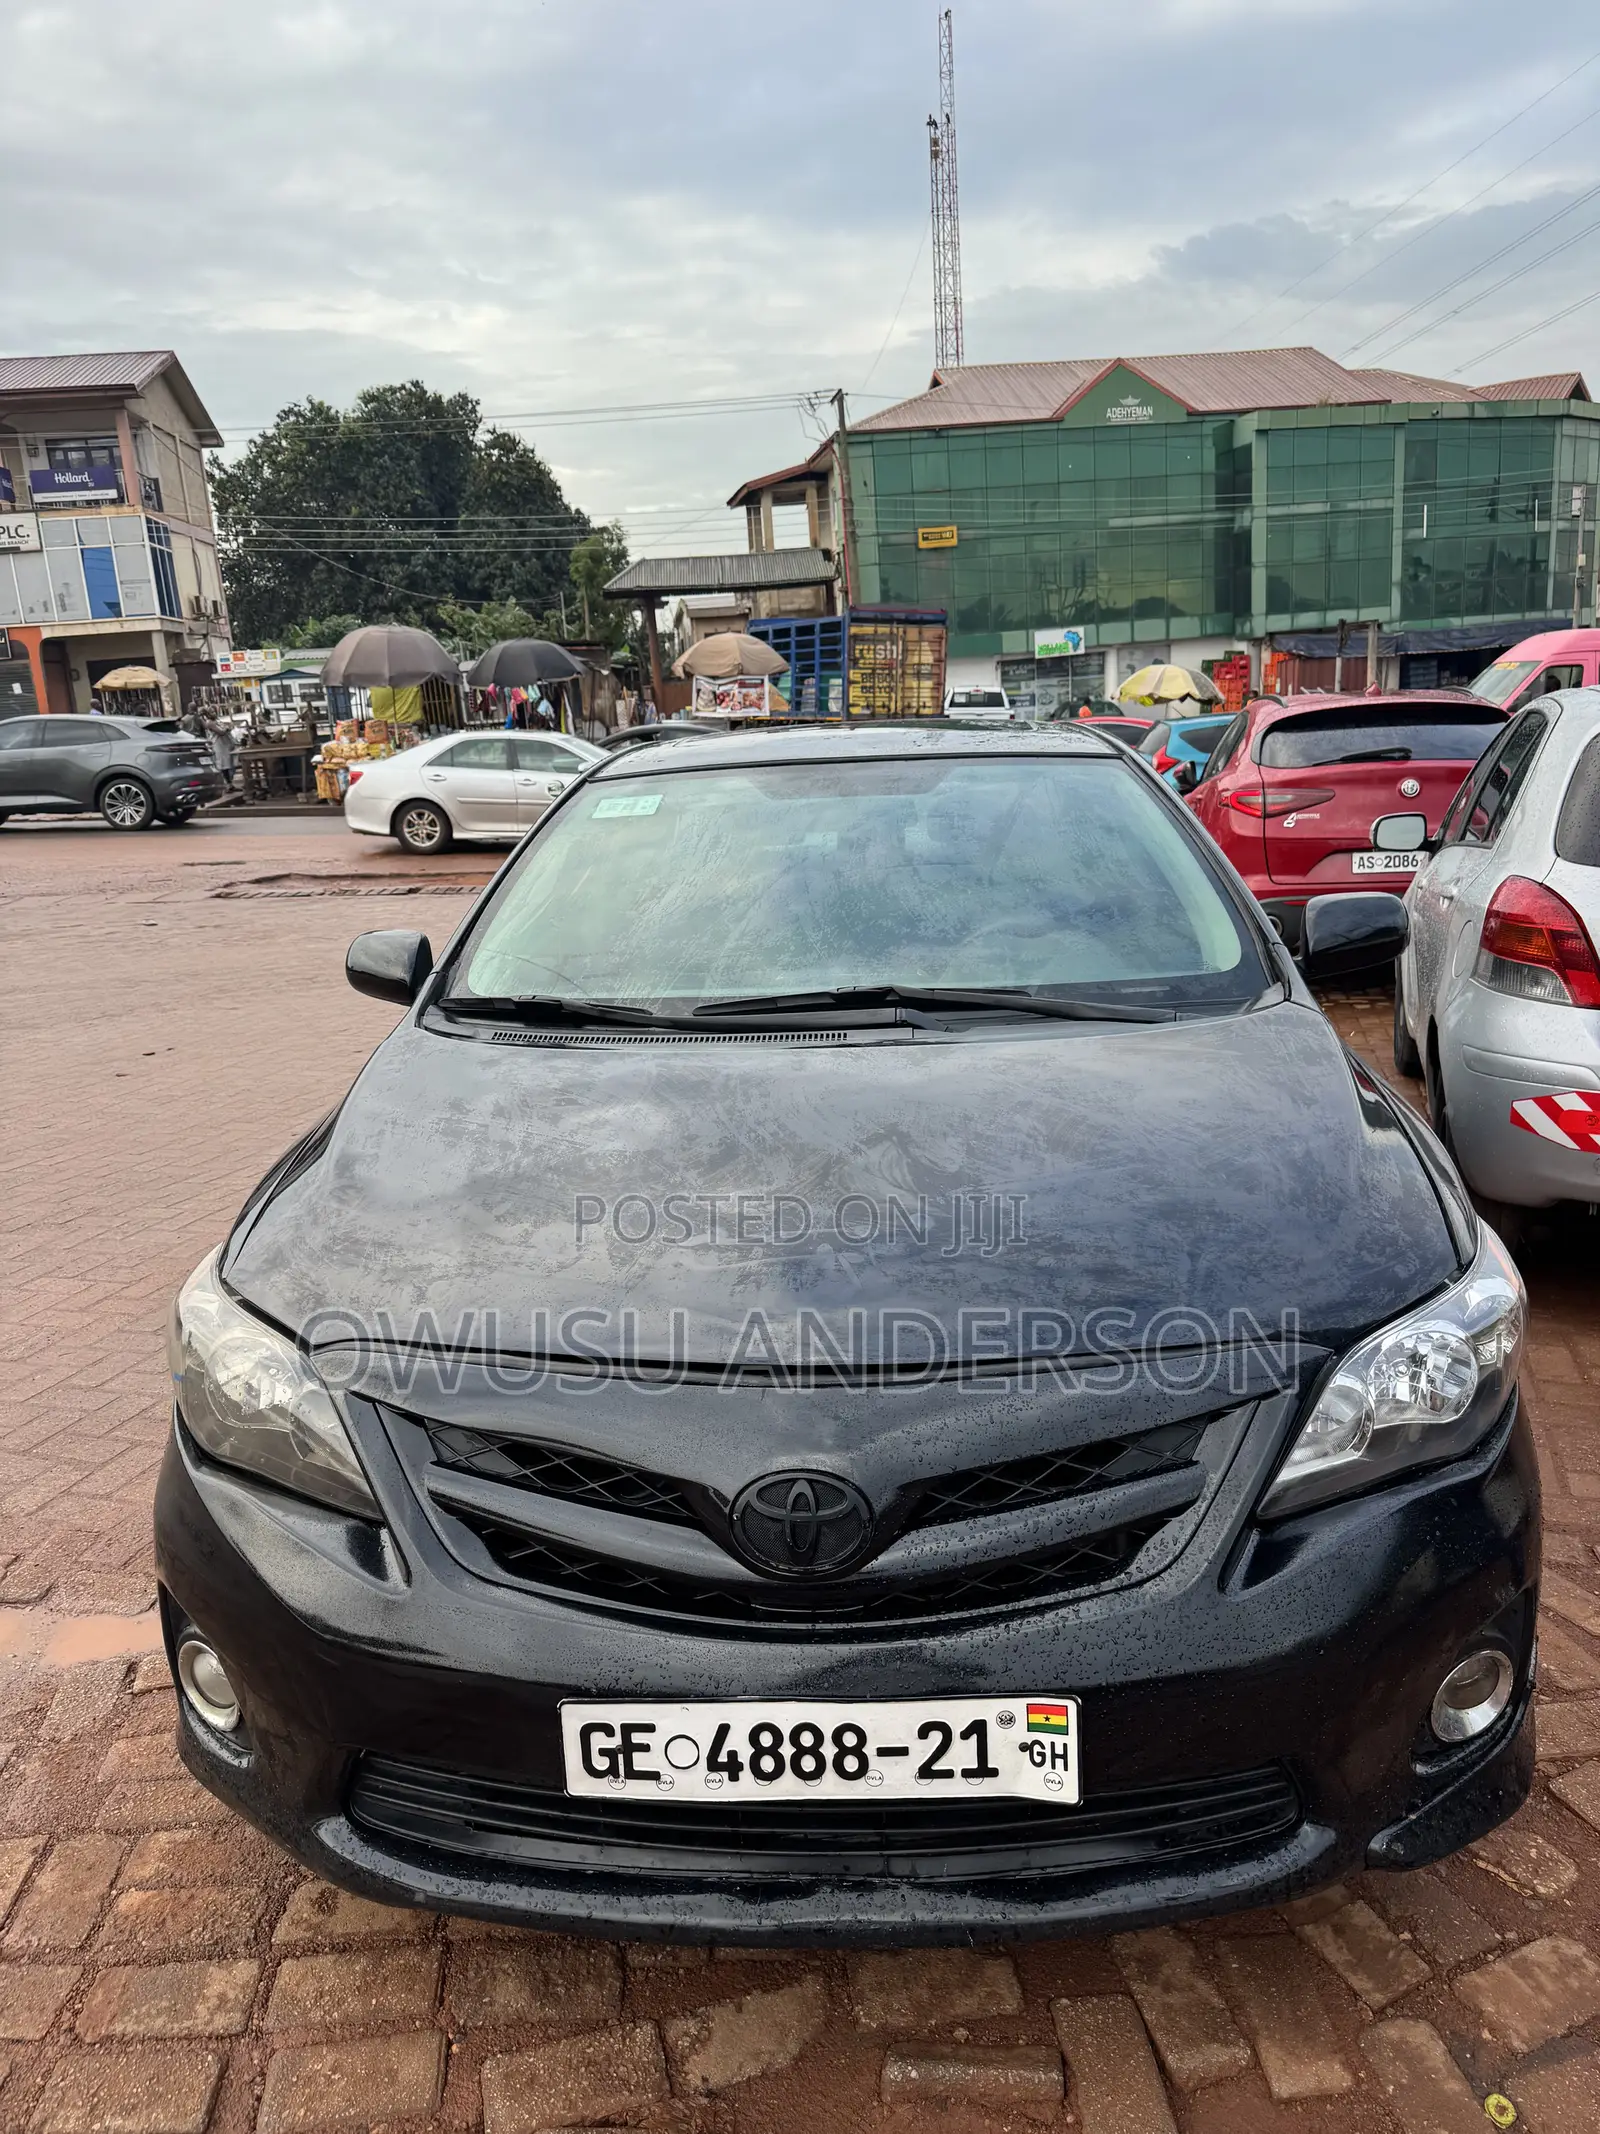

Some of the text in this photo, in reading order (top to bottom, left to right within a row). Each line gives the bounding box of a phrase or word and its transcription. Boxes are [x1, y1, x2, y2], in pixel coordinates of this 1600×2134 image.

[1106, 406, 1153, 419] ADEHYEMAN
[1357, 854, 1419, 869] AS 2086
[579, 1718, 999, 1781] GE 4888-21
[1027, 1739, 1069, 1772] GH
